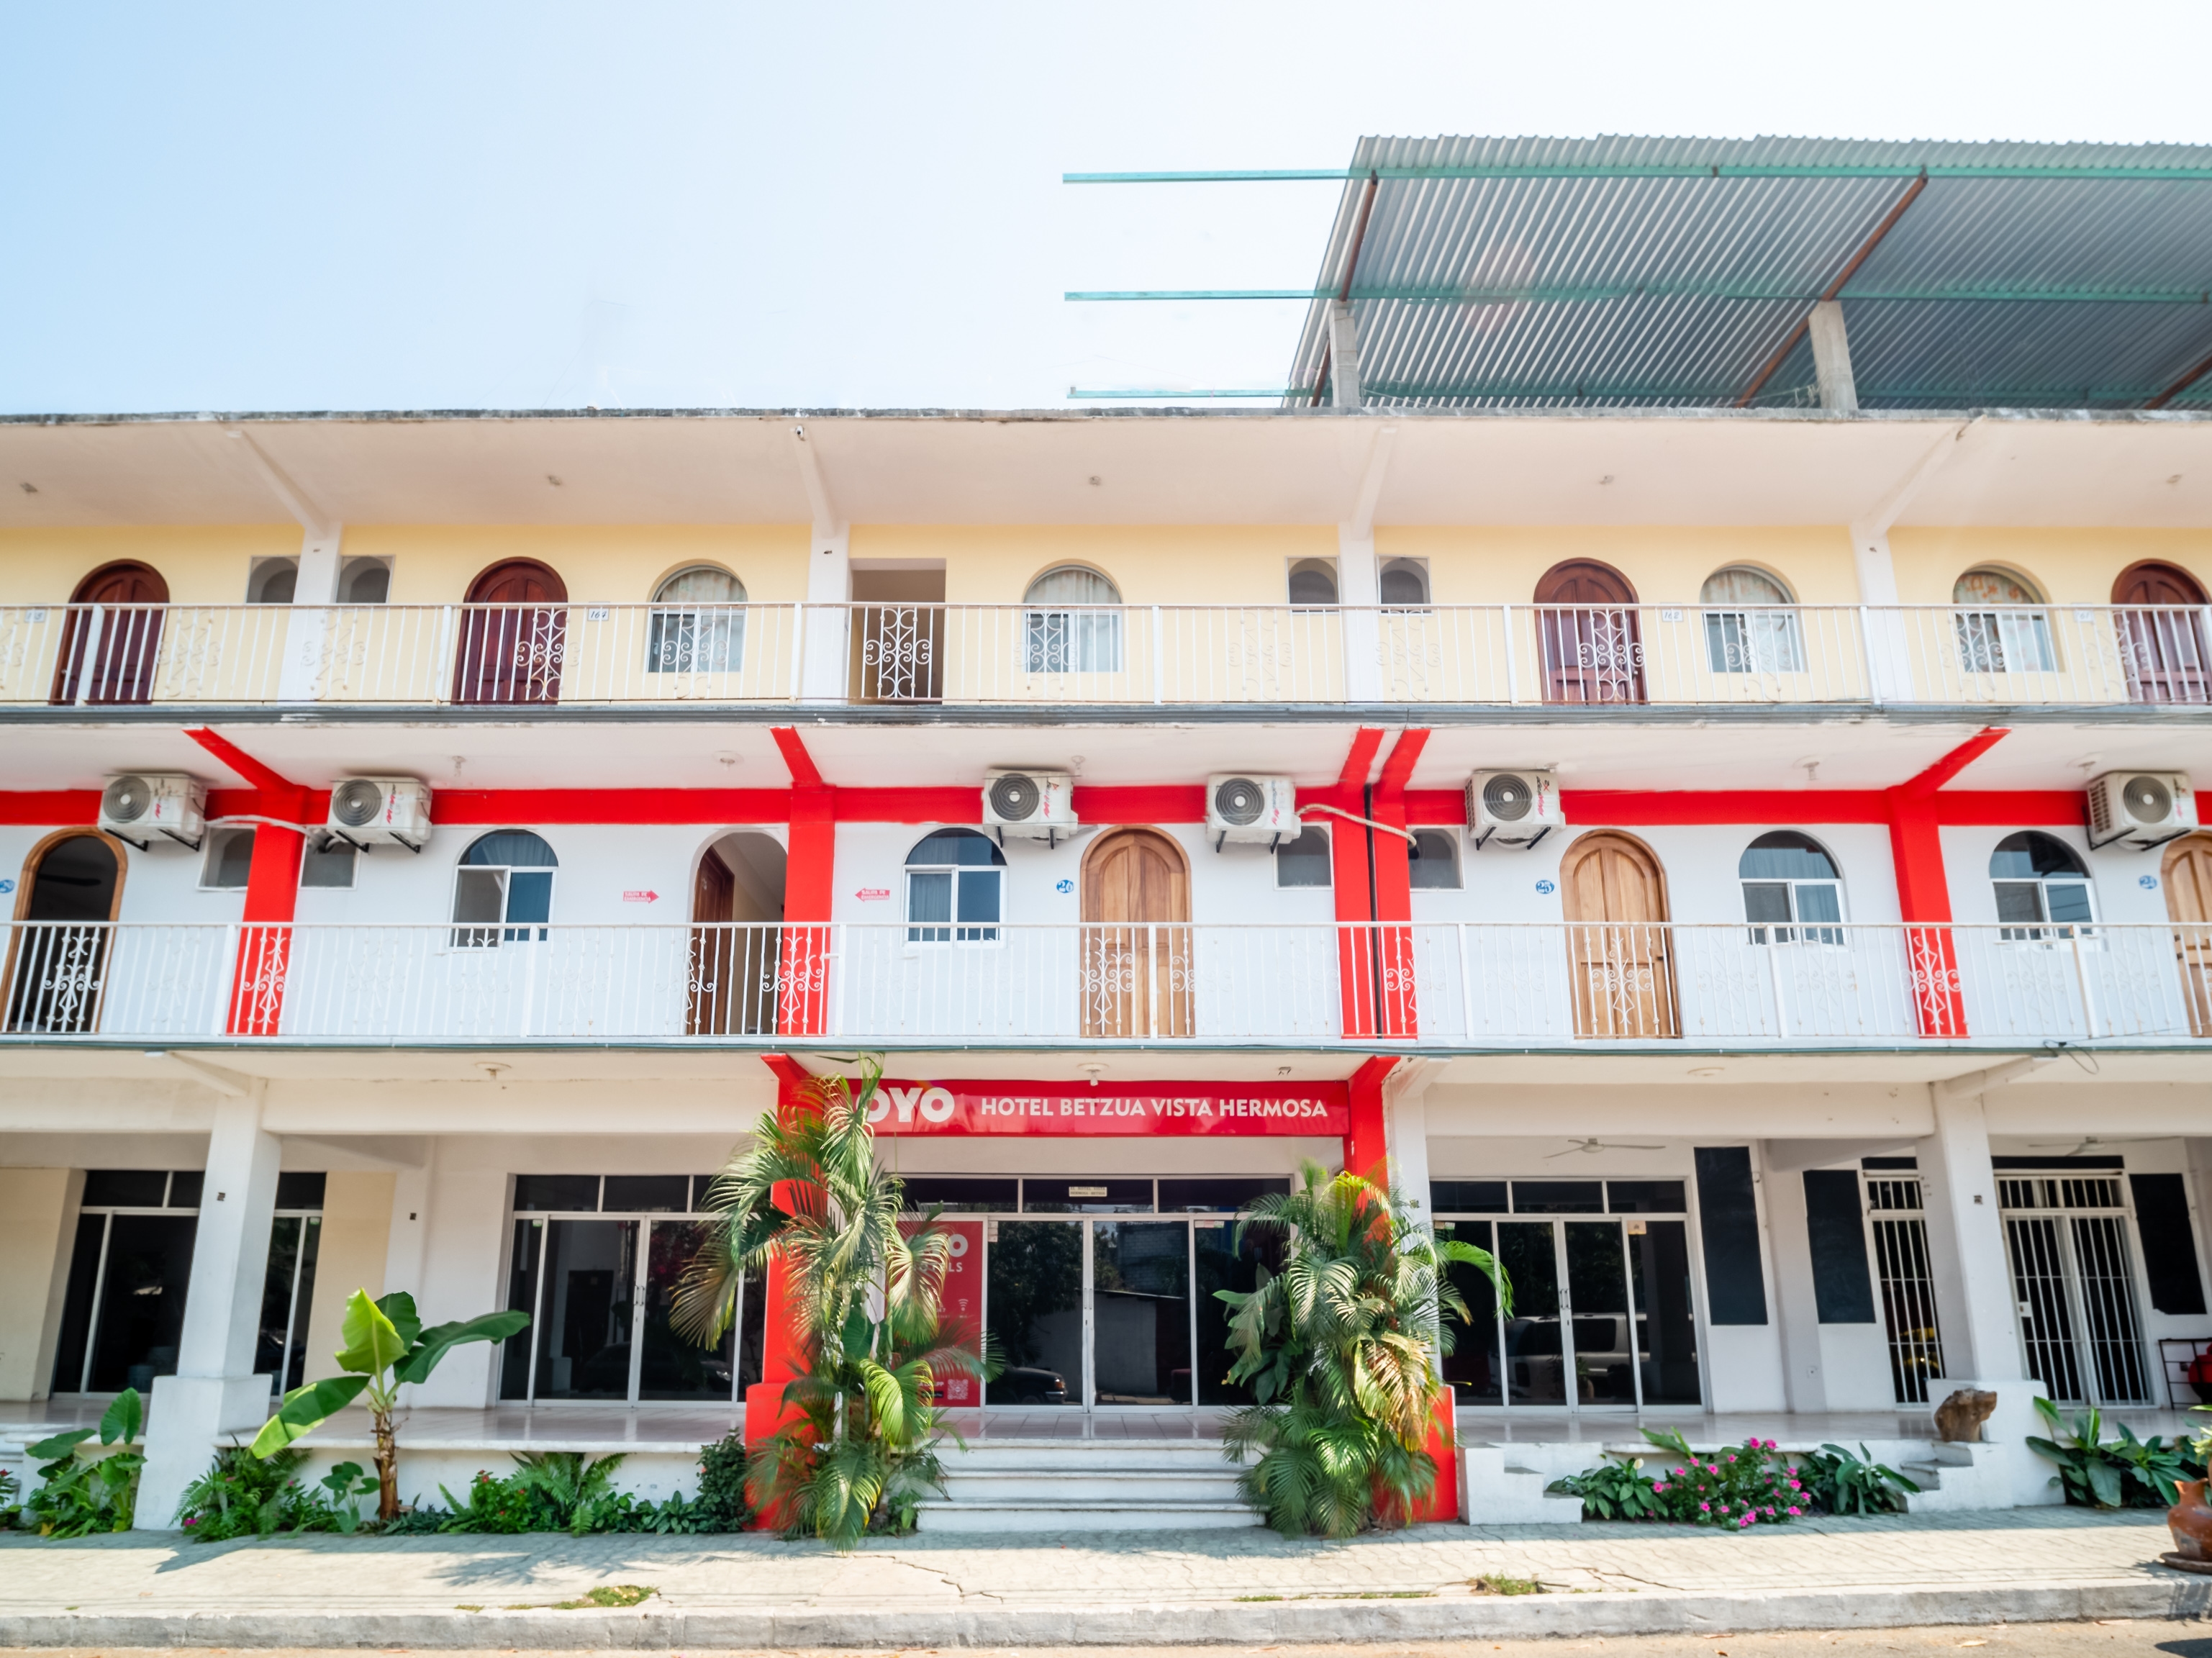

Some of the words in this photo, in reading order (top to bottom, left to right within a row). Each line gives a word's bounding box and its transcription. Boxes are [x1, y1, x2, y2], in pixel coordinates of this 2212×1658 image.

[1058, 881, 1074, 892] 26
[1537, 881, 1552, 893] 25
[856, 1087, 955, 1123] OYO
[982, 1098, 1053, 1115] HOTEL
[1061, 1098, 1146, 1116] BETZUA
[1151, 1099, 1213, 1117] VISTA
[1220, 1099, 1328, 1118] HERMOSA
